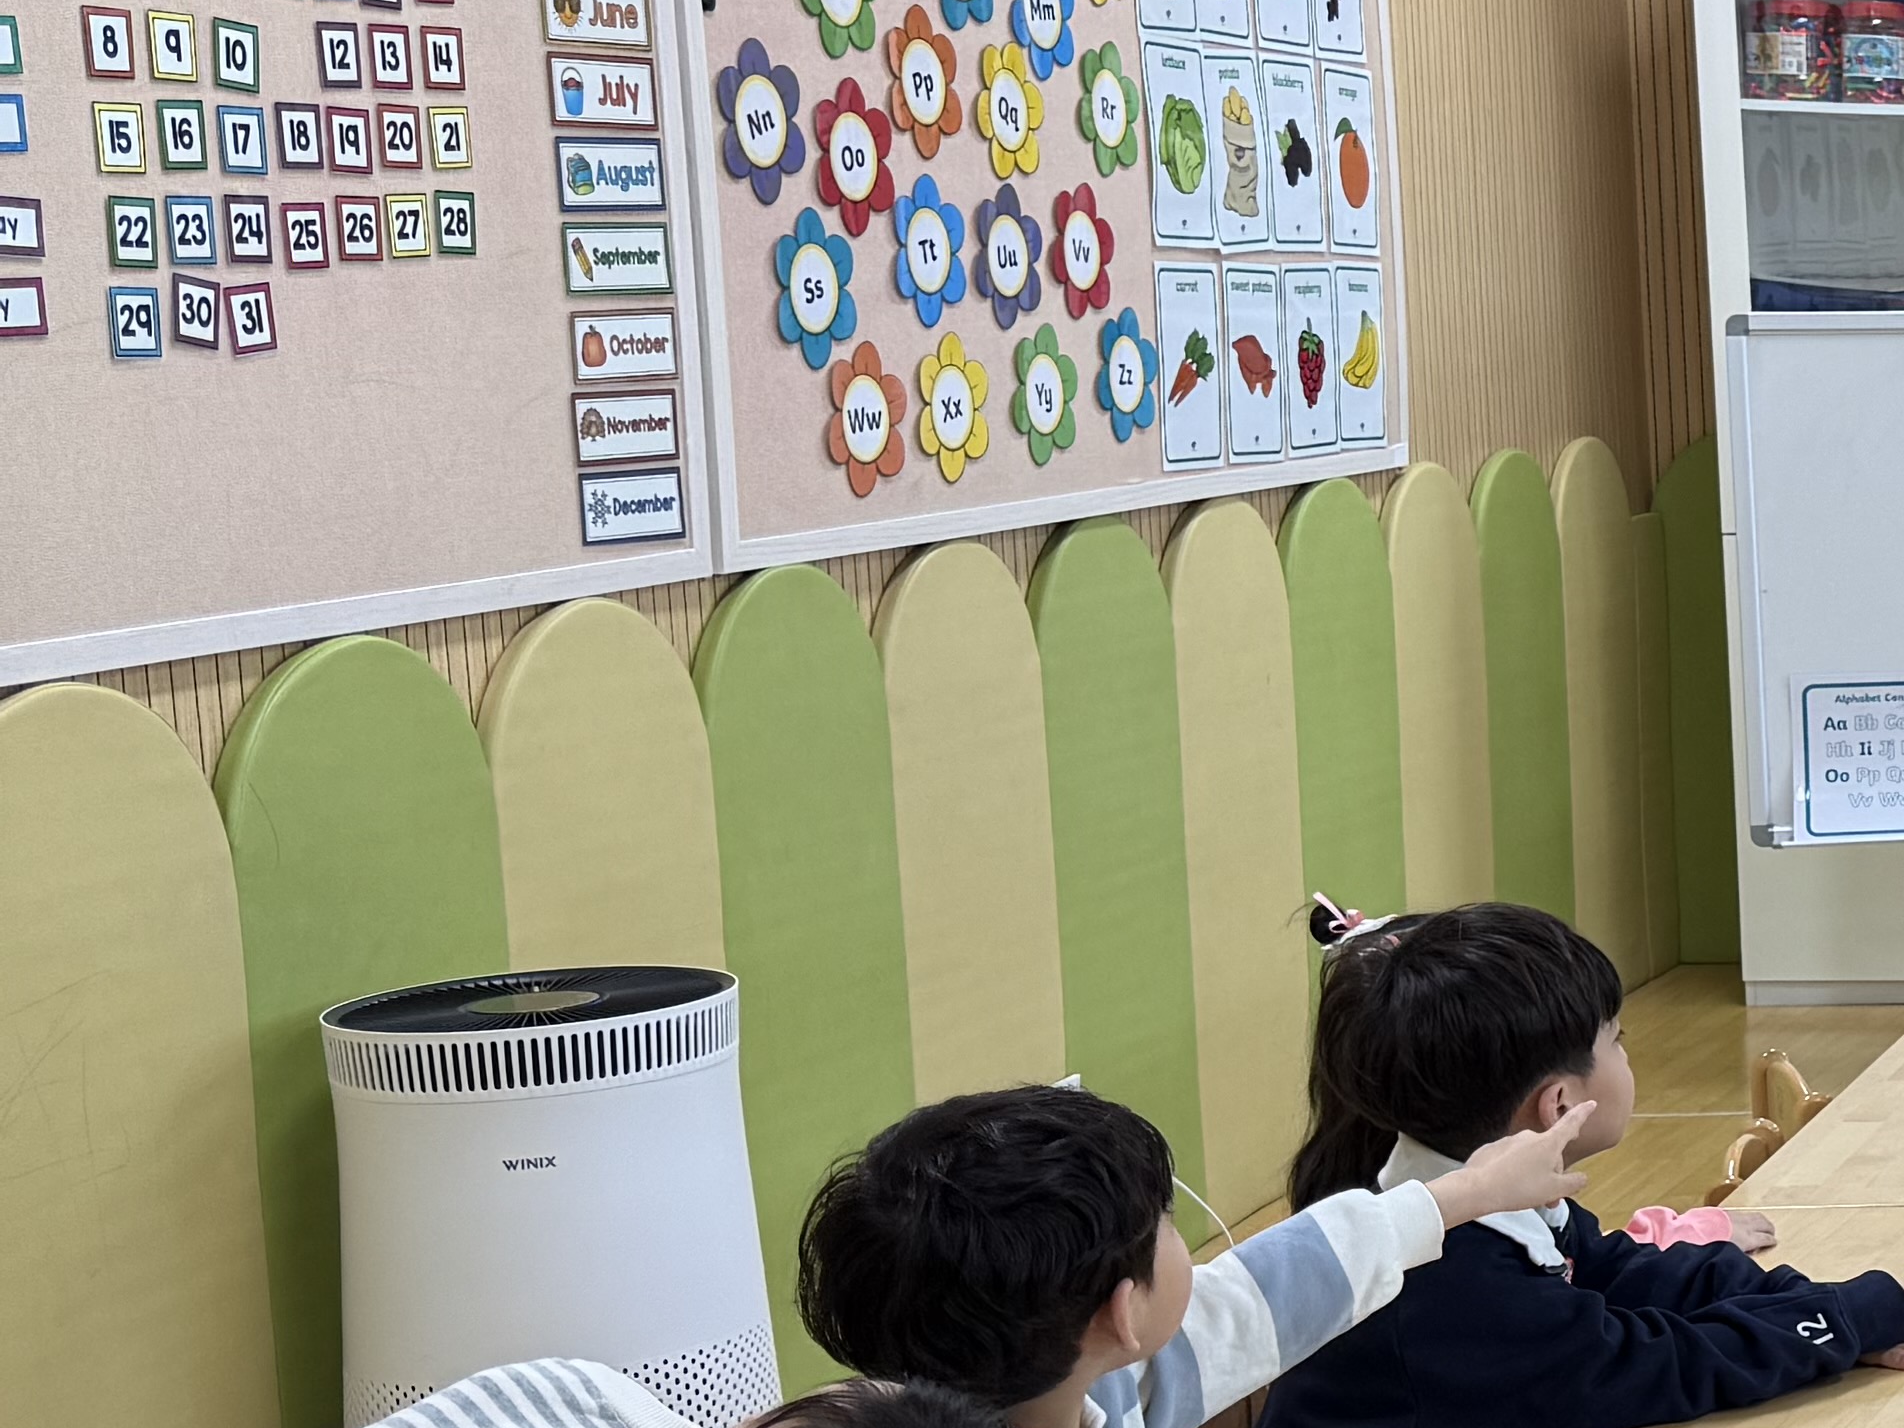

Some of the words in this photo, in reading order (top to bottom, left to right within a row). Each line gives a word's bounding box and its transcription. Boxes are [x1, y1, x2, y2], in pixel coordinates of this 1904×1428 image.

[102, 24, 119, 59] 8
[164, 28, 183, 63] 9
[224, 36, 247, 72] 10
[329, 37, 351, 70] 12
[379, 39, 400, 72] 13
[432, 41, 453, 73] 14
[599, 74, 639, 115] July
[912, 71, 934, 102] Pp
[998, 96, 1020, 133] Qq
[1100, 96, 1117, 121] Rr
[108, 119, 132, 154] 15
[170, 116, 194, 150] 16
[231, 122, 251, 155] 17
[289, 119, 311, 152] 18
[338, 122, 361, 156] 19
[386, 120, 414, 151] 20
[442, 121, 461, 152] 21
[746, 109, 775, 139] Nn
[841, 145, 865, 172] Oo
[596, 159, 655, 192] August
[117, 214, 150, 249] 22
[175, 213, 207, 246] 23
[233, 212, 264, 245] 24
[291, 218, 320, 251] 25
[345, 212, 374, 244] 26
[395, 209, 420, 241] 27
[442, 206, 469, 237] 28
[593, 246, 660, 269] September
[918, 238, 938, 264] Tt
[997, 244, 1018, 269] Uu
[1072, 238, 1090, 264] Vv
[803, 277, 824, 304] Ss
[119, 304, 153, 338] 29
[181, 292, 212, 328] 30
[240, 298, 264, 335] 31
[609, 332, 669, 356] October
[1118, 363, 1133, 386] Zz
[941, 396, 963, 423] Xx
[1034, 382, 1053, 413] Yy
[607, 414, 670, 435] November
[847, 406, 882, 435] Ww
[613, 493, 676, 516] December
[1835, 693, 1881, 705] Alphabet
[1824, 717, 1847, 731] Aa
[1859, 742, 1872, 756] Ii
[1825, 769, 1849, 782] Oo
[502, 1156, 557, 1171] WINIX
